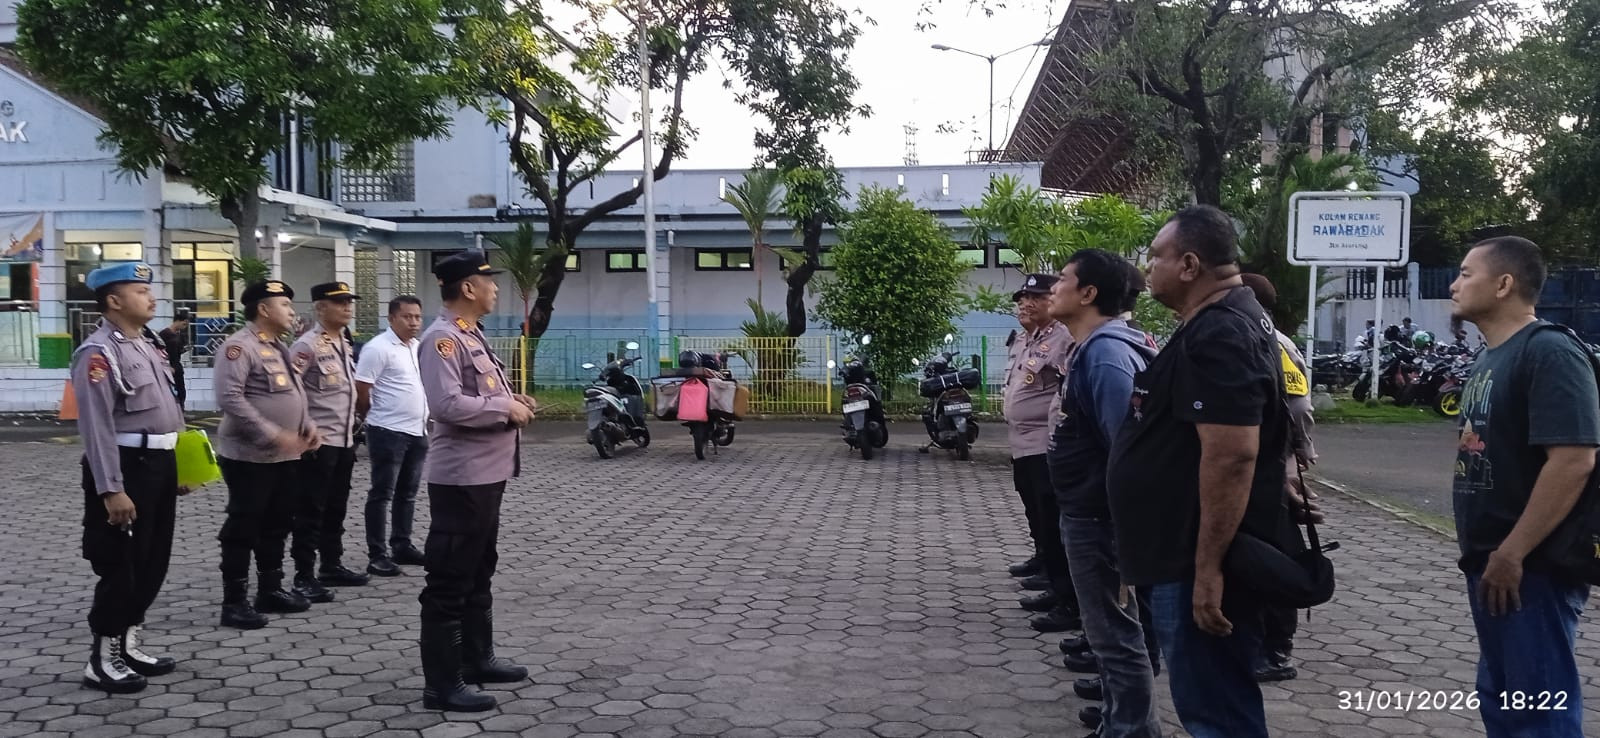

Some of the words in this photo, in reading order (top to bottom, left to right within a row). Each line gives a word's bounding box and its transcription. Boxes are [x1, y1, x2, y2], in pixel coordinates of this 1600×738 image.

[1319, 213, 1346, 221] KOLAM
[1348, 212, 1381, 221] RENANG
[1313, 224, 1385, 236] RAWABADAK
